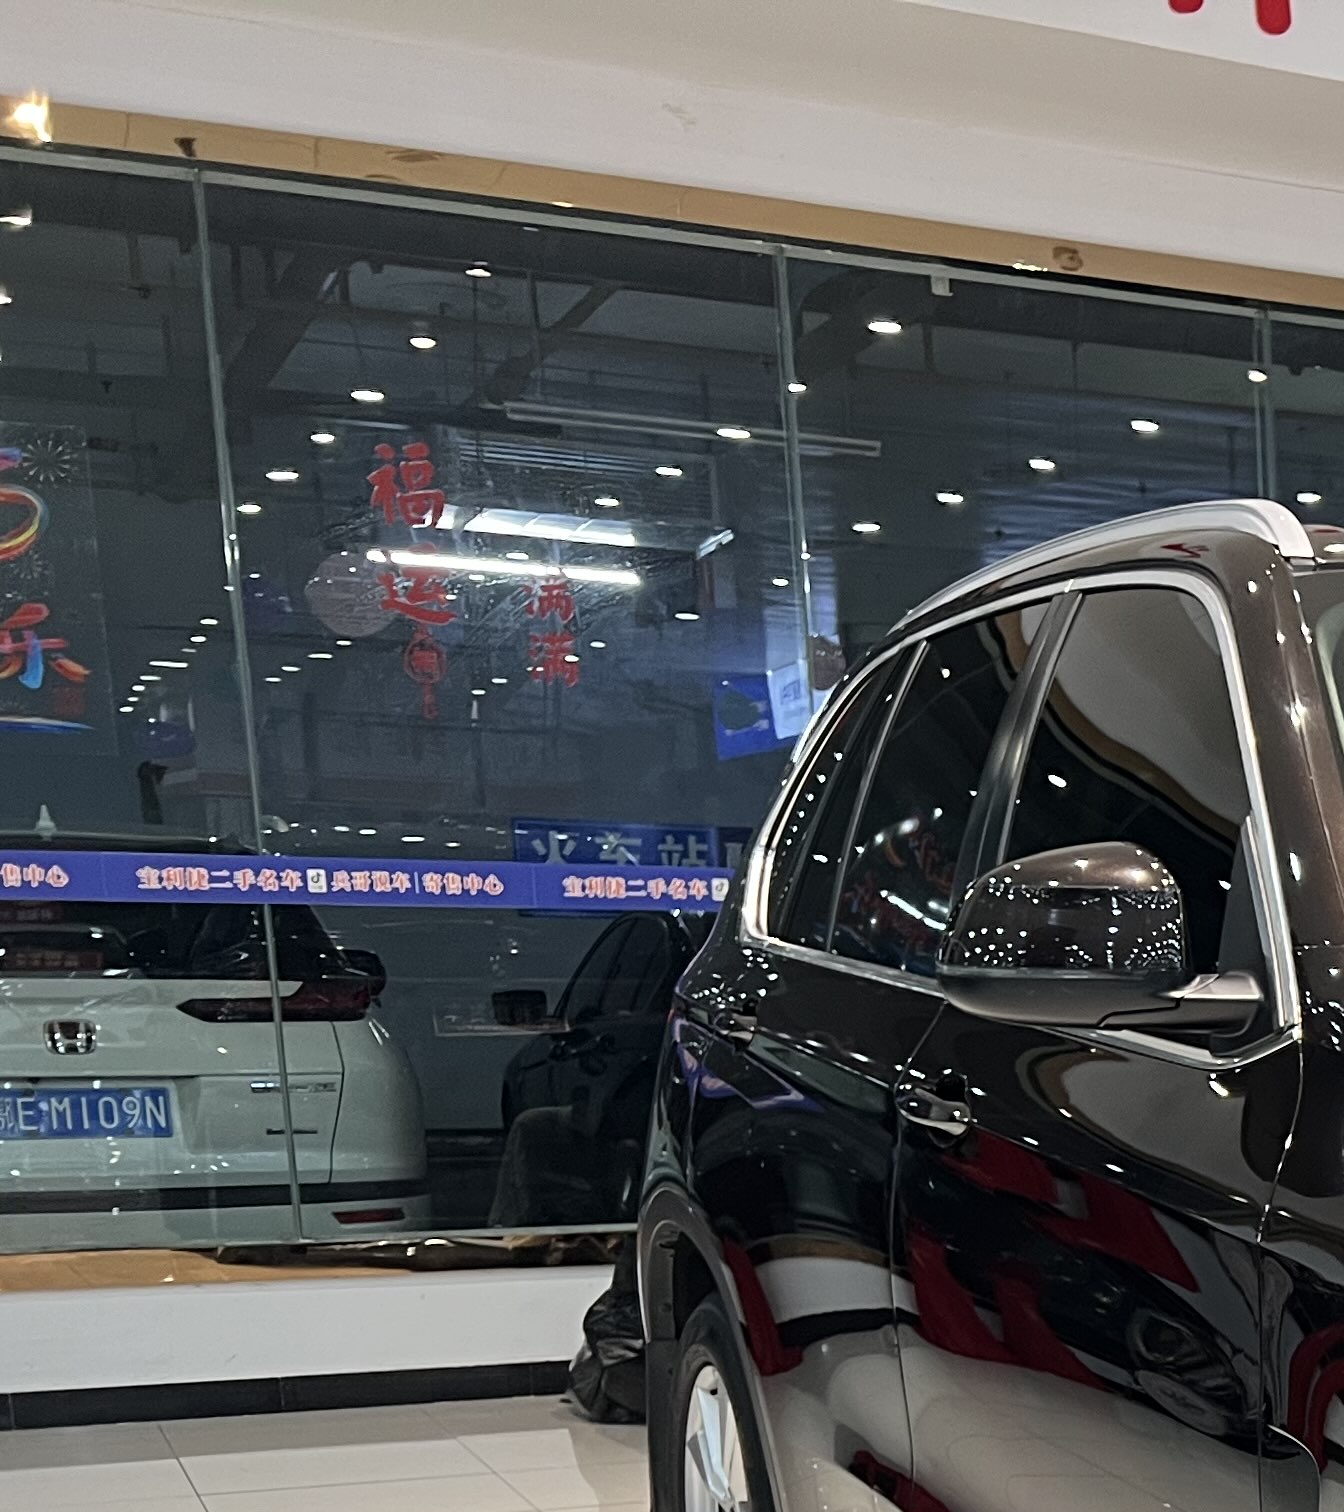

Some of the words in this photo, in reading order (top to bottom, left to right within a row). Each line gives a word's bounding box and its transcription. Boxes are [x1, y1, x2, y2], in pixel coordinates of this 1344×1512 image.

[135, 865, 304, 892] 宝利捷二手名车
